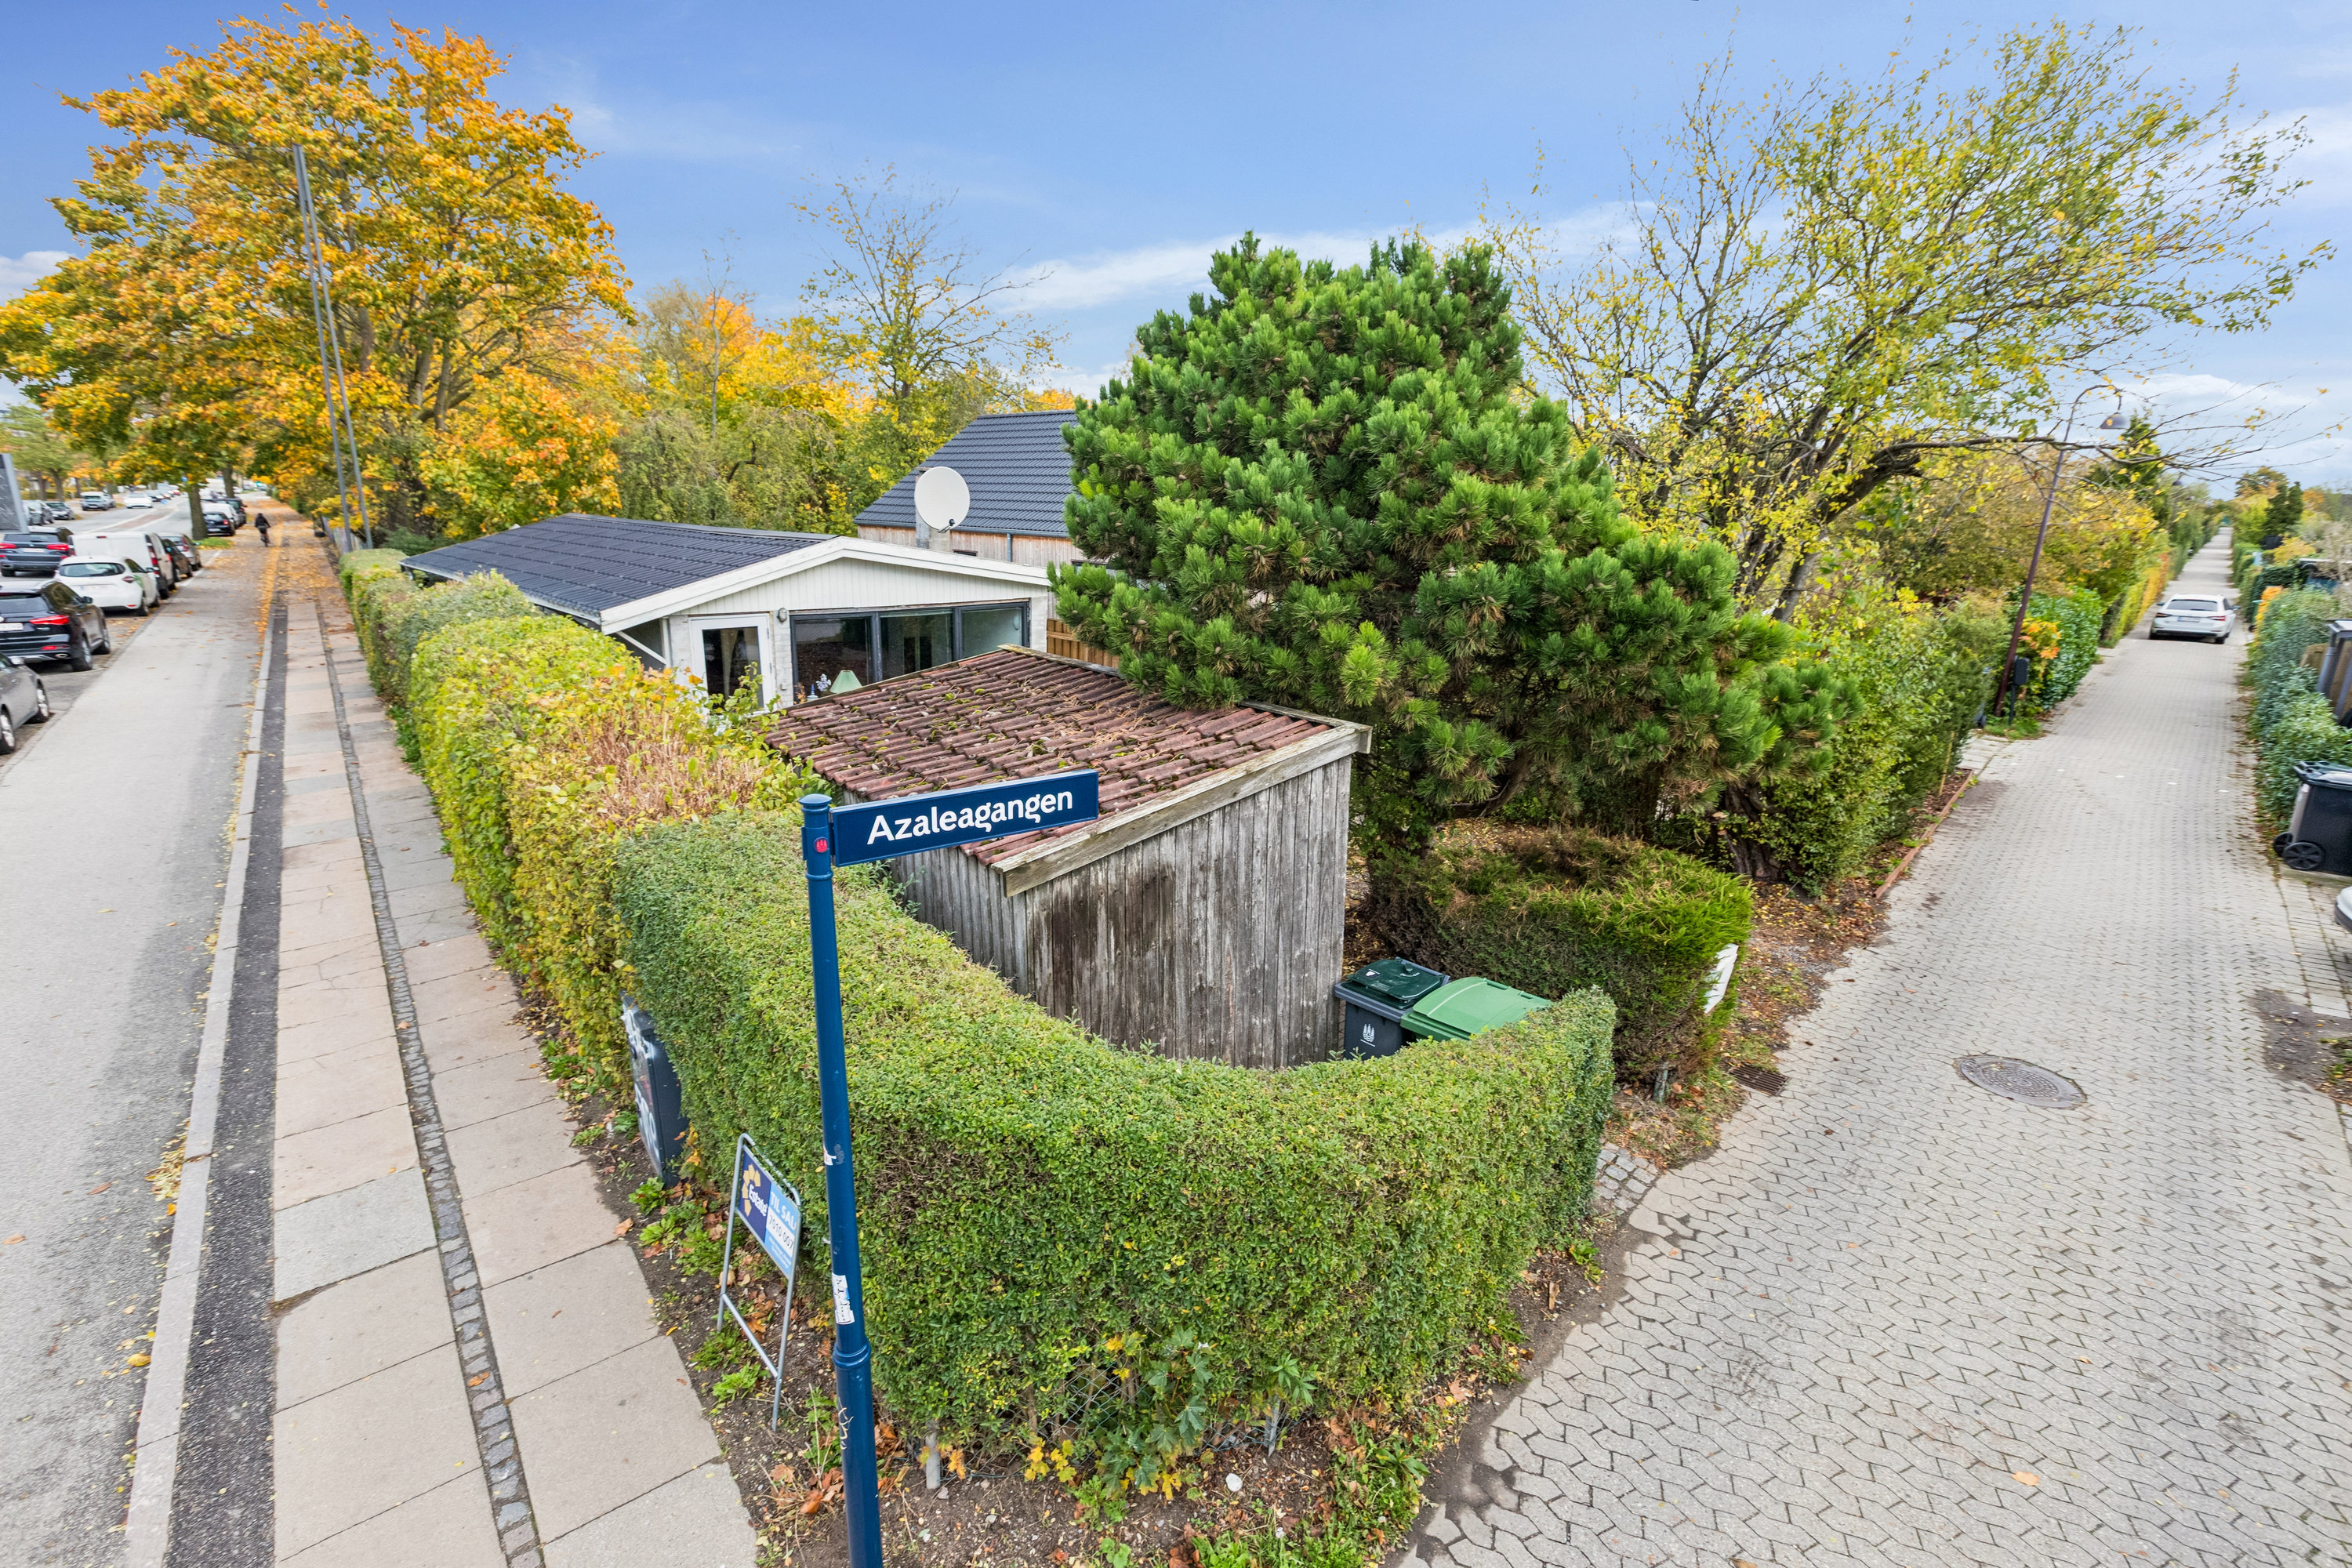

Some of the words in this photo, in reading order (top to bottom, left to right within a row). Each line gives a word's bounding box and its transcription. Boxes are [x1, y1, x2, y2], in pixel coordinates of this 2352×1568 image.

[867, 791, 1073, 844] Azaleagangen
[749, 1184, 768, 1217] Estate
[770, 1191, 780, 1214] TIL
